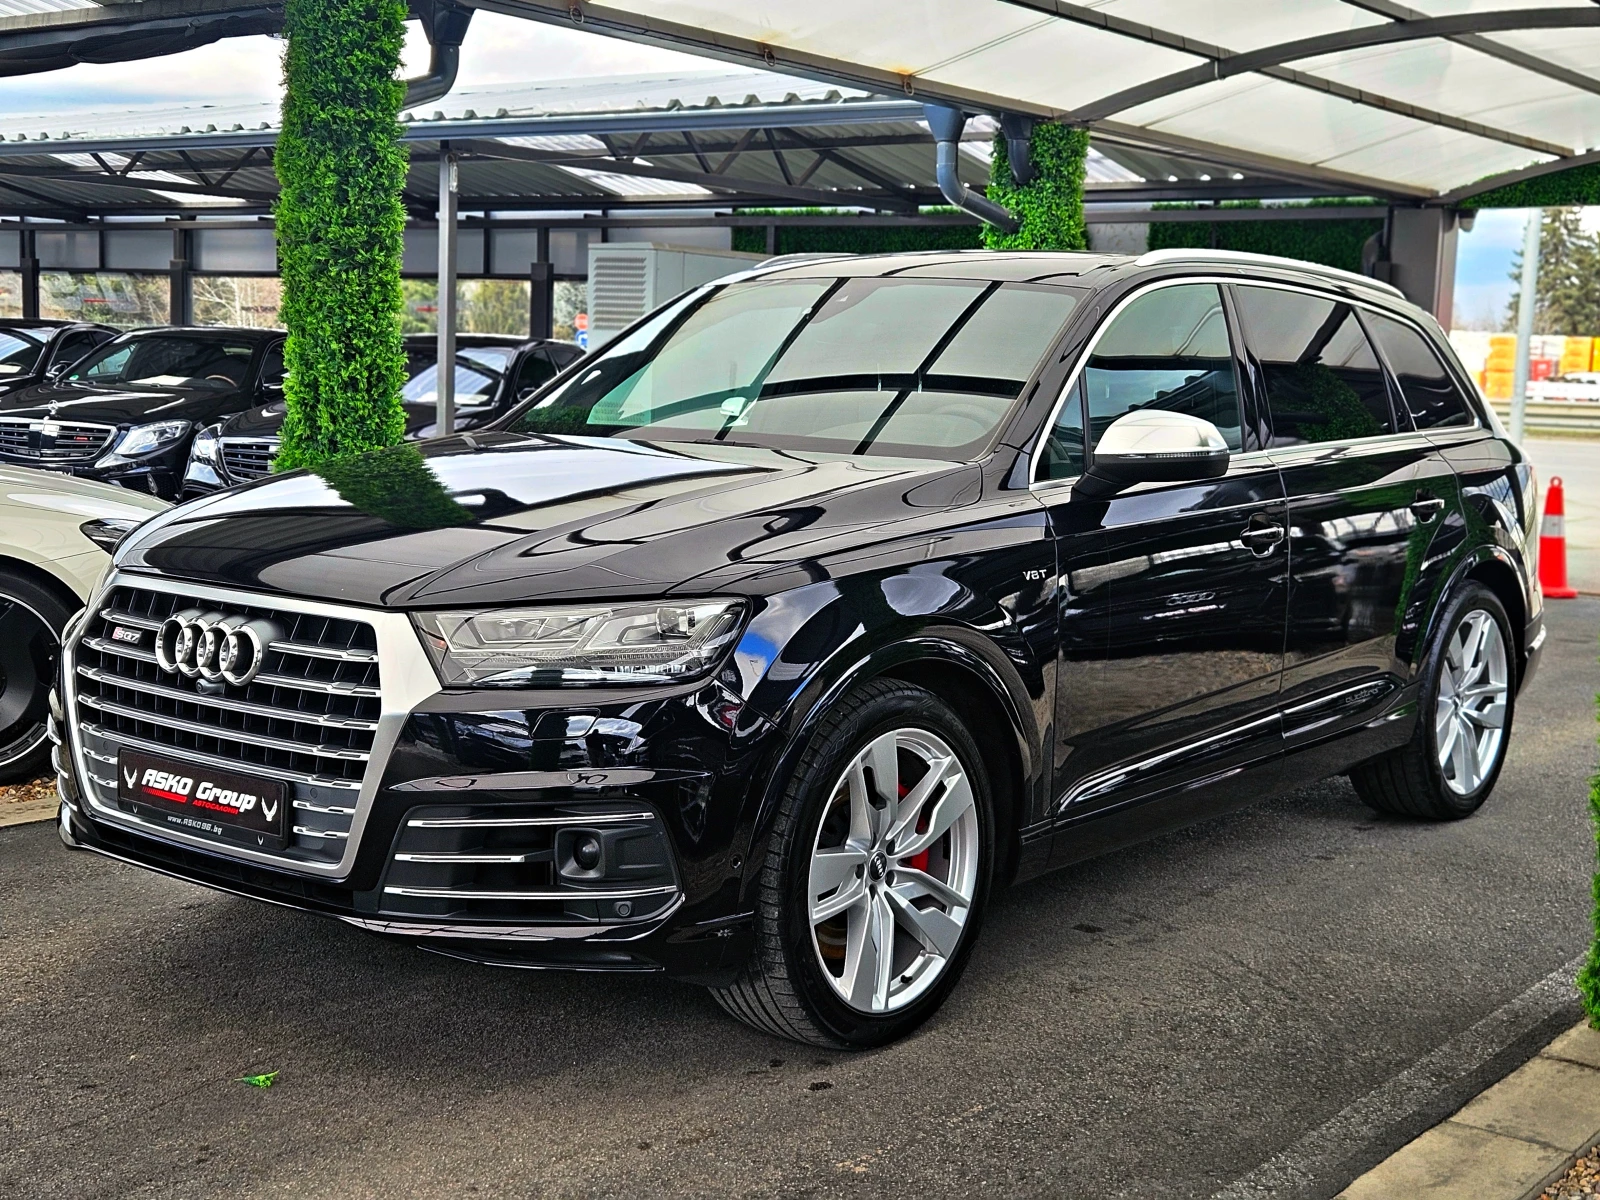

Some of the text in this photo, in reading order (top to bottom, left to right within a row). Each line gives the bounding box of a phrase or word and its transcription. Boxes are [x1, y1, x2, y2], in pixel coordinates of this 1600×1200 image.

[1022, 569, 1047, 581] V8T
[115, 628, 140, 642] SQ7
[141, 768, 257, 813] ASKO Group
